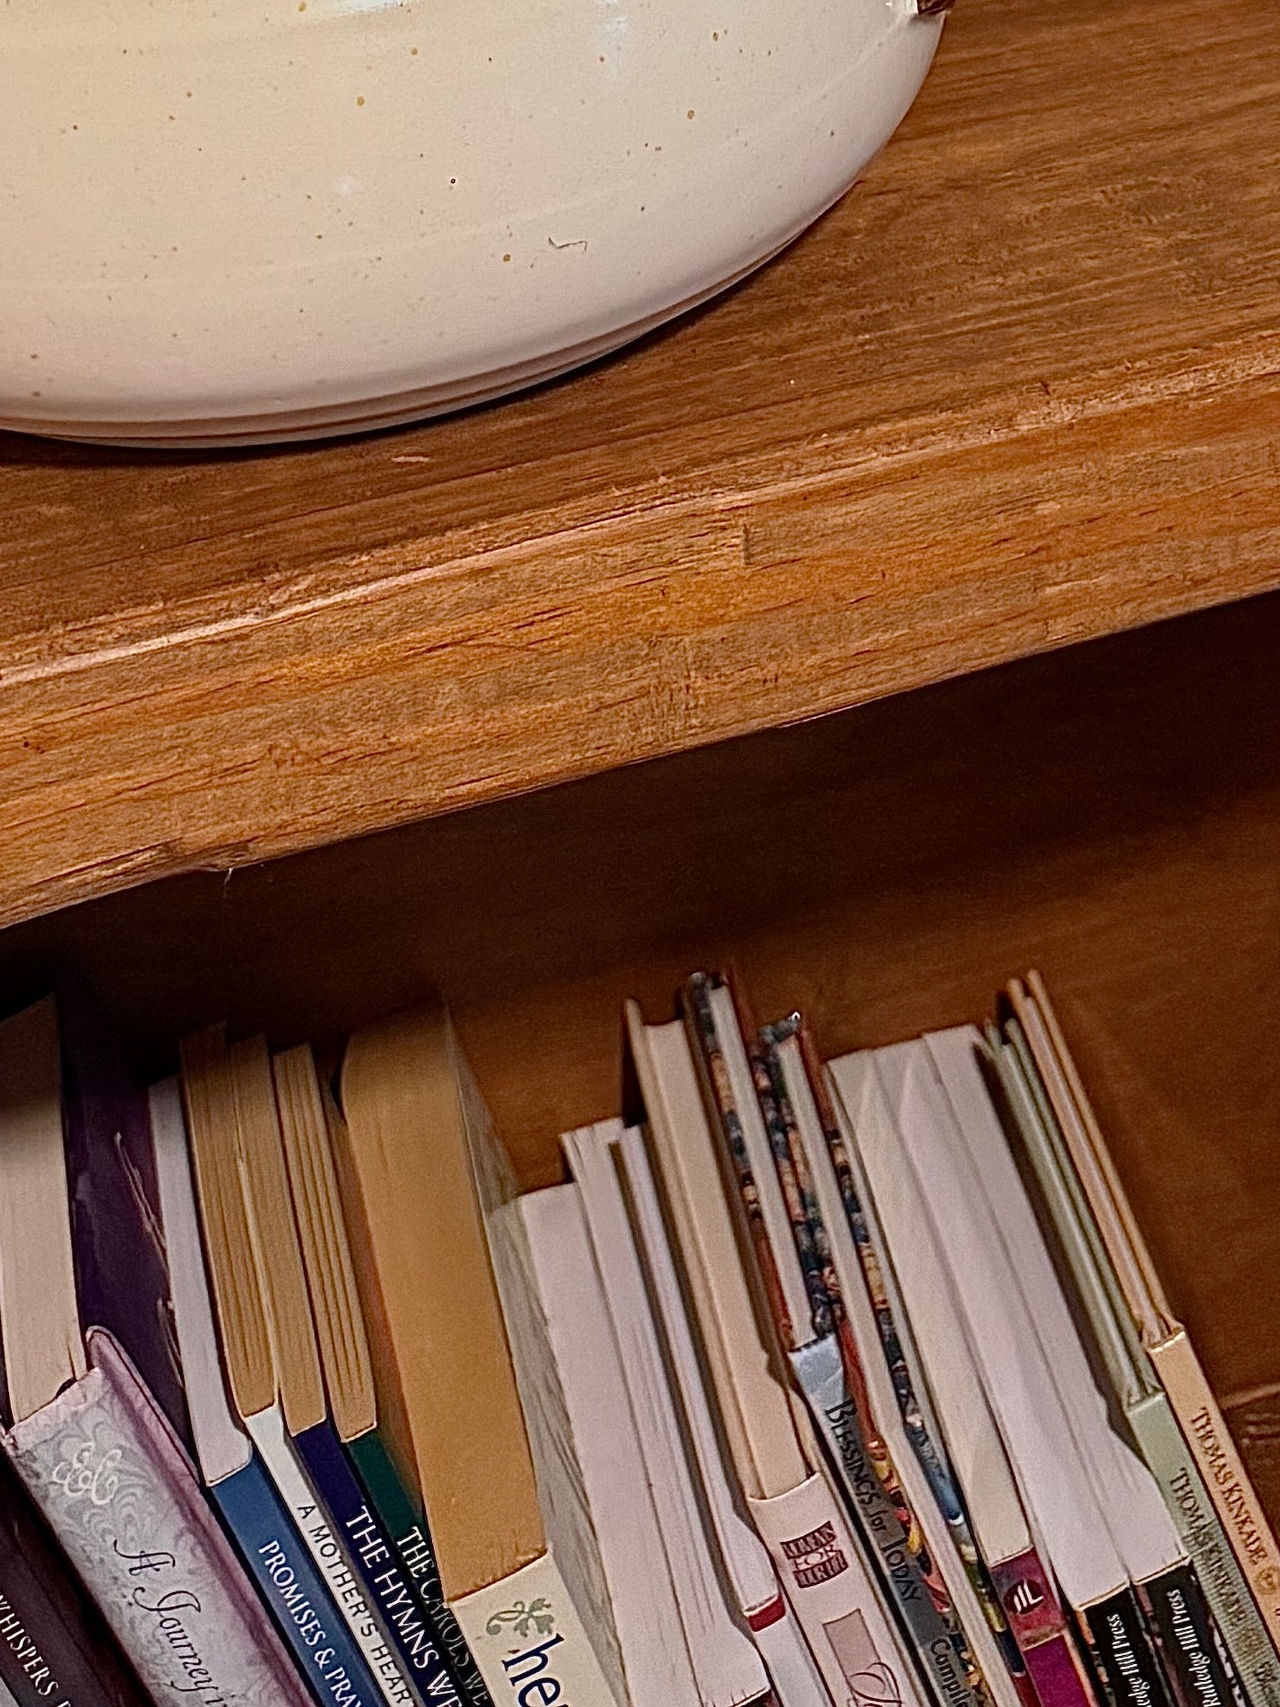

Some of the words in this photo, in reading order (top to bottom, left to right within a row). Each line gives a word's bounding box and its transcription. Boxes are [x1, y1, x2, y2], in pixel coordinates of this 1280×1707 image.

[1191, 1407, 1234, 1487] THOMAS
[1221, 1482, 1269, 1565] KINKADE
[870, 1508, 888, 1533] for
[397, 1526, 432, 1579] THE
[258, 1540, 327, 1647] PROMISES
[297, 1505, 318, 1520] A
[309, 1525, 379, 1638] MOTHER'S
[370, 1644, 417, 1707] HEAR
[345, 1506, 391, 1570] THE
[374, 1569, 440, 1670] HYMNS
[1166, 1589, 1191, 1625] Press
[132, 1586, 219, 1694] Journey
[314, 1647, 336, 1670] &
[1106, 1613, 1130, 1649] Press
[324, 1666, 363, 1707] PRA
[501, 1633, 569, 1707] he
